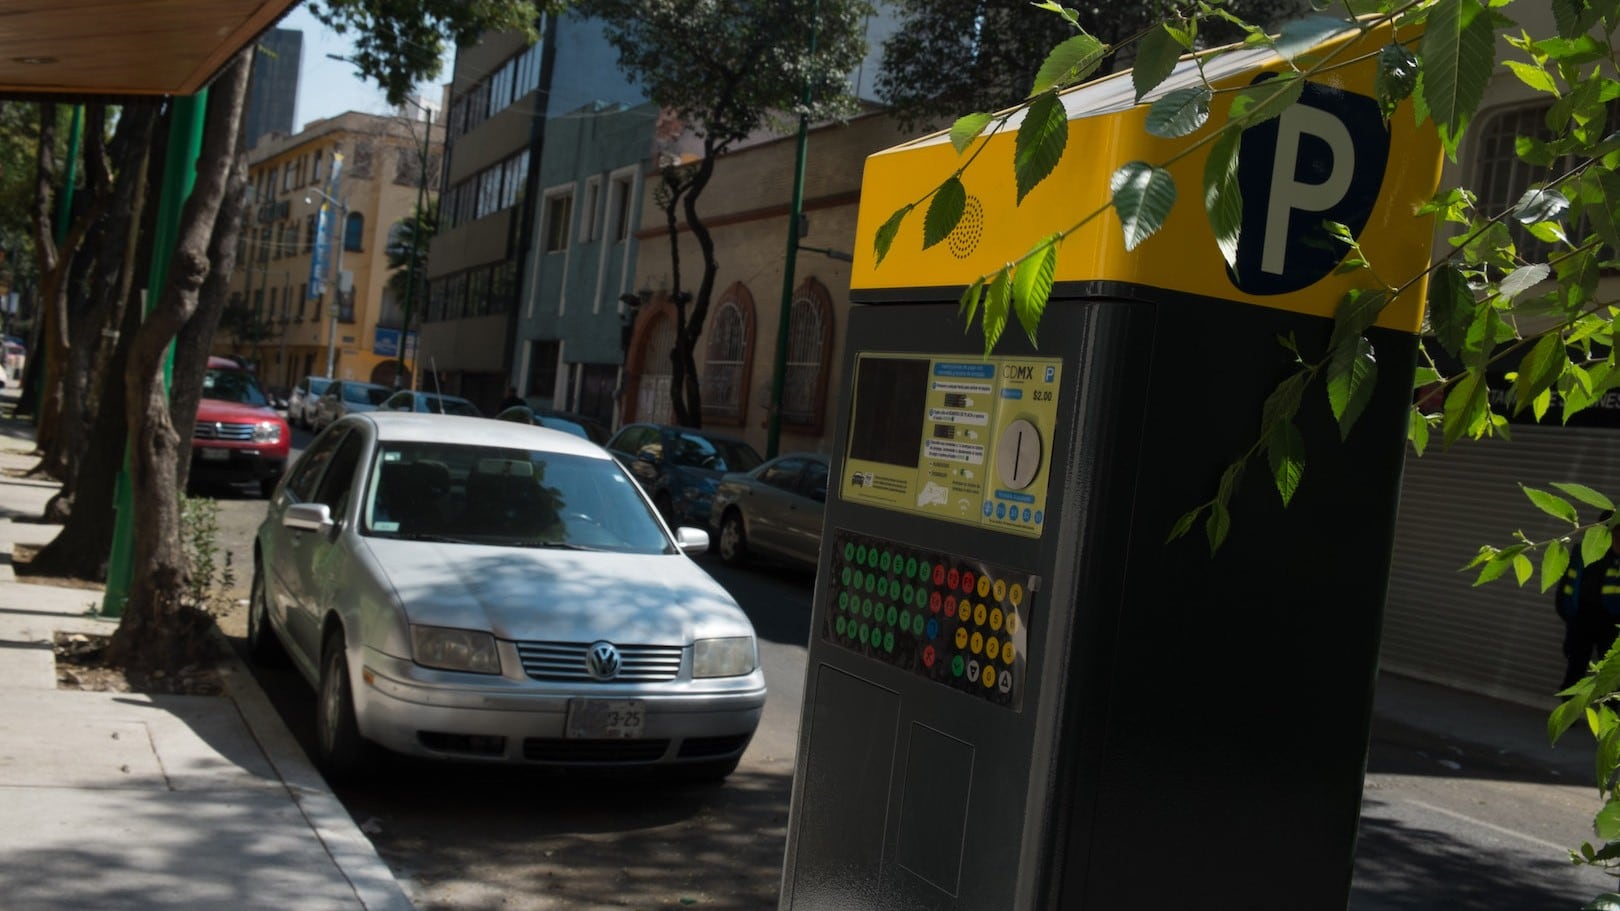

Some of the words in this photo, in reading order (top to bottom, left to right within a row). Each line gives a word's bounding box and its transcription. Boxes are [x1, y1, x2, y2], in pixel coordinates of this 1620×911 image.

[1261, 103, 1356, 275] P
[1003, 365, 1034, 380] CDMX
[1047, 367, 1055, 380] P
[1033, 390, 1053, 401] $2.00
